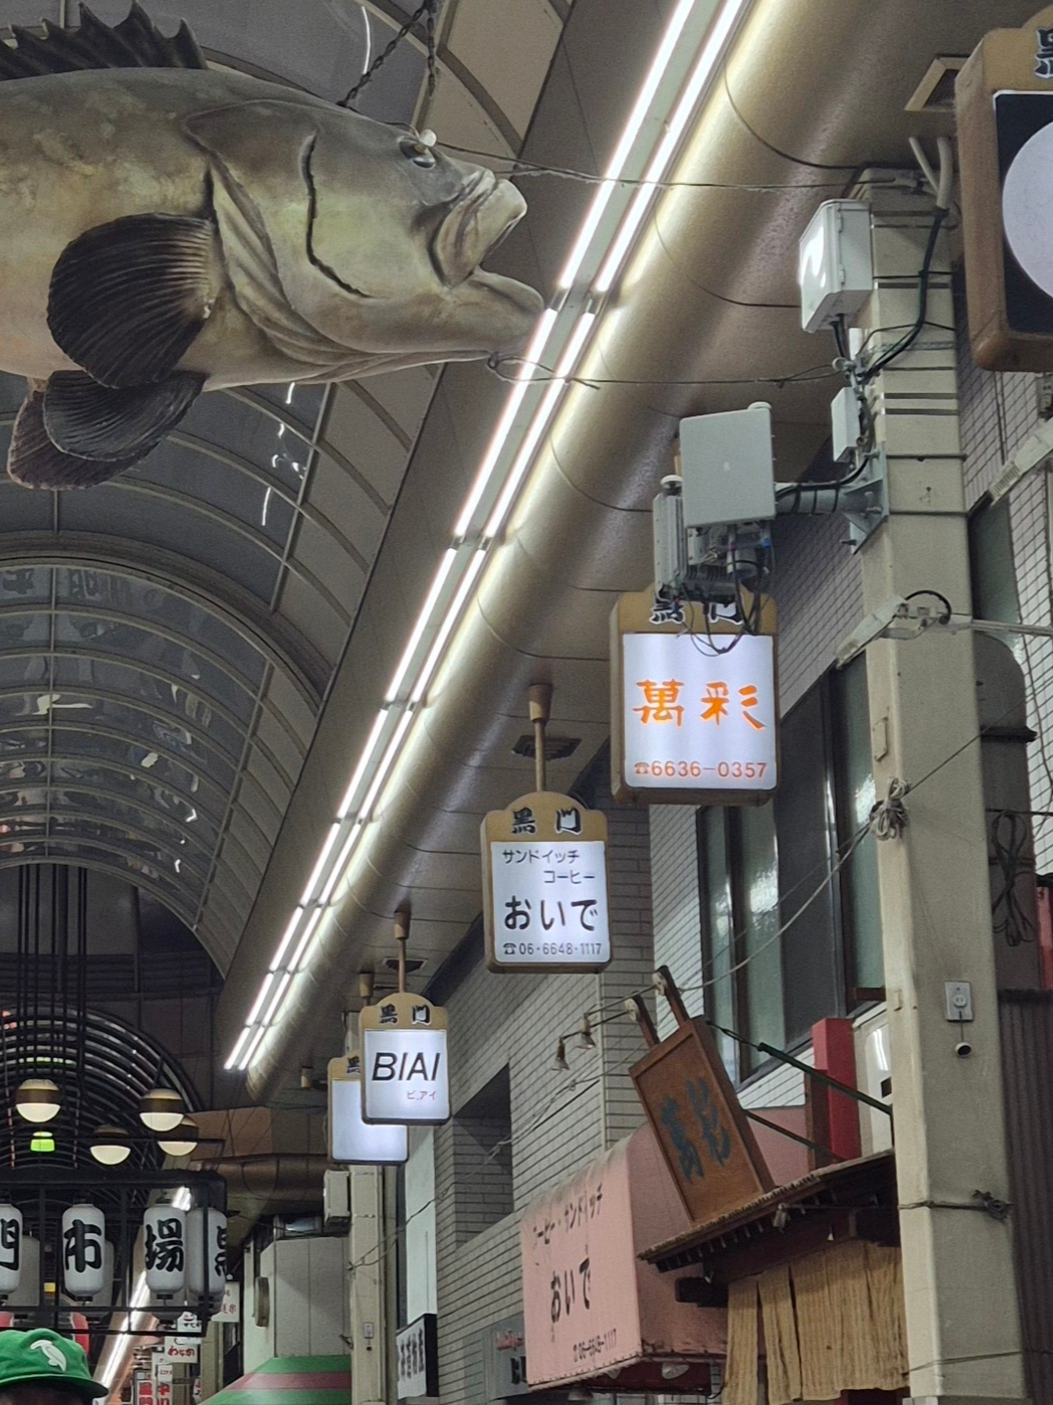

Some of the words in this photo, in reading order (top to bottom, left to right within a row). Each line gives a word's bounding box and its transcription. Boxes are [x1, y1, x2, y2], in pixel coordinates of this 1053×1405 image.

[632, 679, 767, 730] 萬彩
[512, 807, 582, 834] 黒門
[502, 850, 580, 864] サンドイッチ
[544, 870, 595, 884] コーヒー
[504, 895, 599, 931] おいで
[379, 1003, 432, 1025] 黒門
[371, 1052, 441, 1081] BIAI
